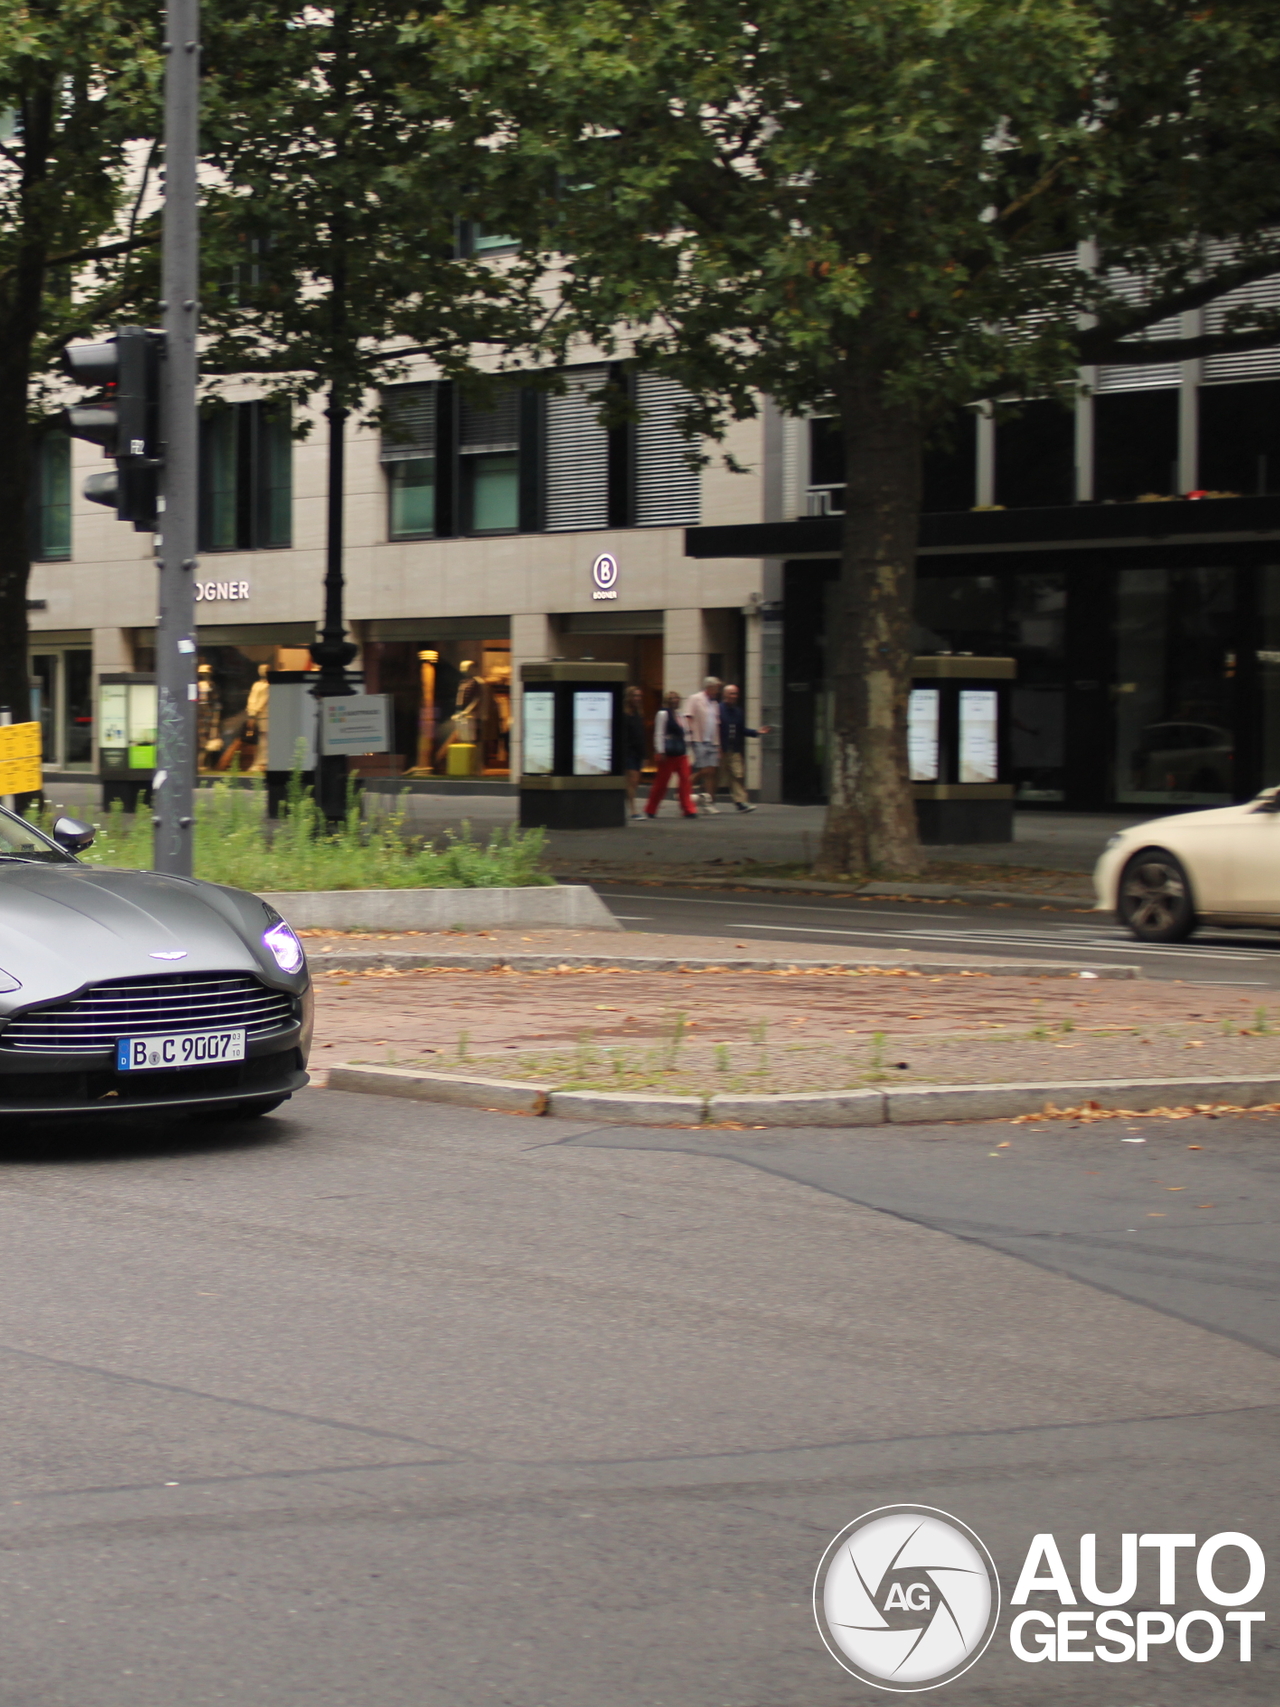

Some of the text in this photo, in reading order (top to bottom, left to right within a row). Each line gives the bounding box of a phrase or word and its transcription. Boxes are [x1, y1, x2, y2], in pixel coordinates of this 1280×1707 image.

[600, 560, 611, 581] B
[195, 581, 250, 601] OGNER
[133, 1034, 232, 1066] B C 9007
